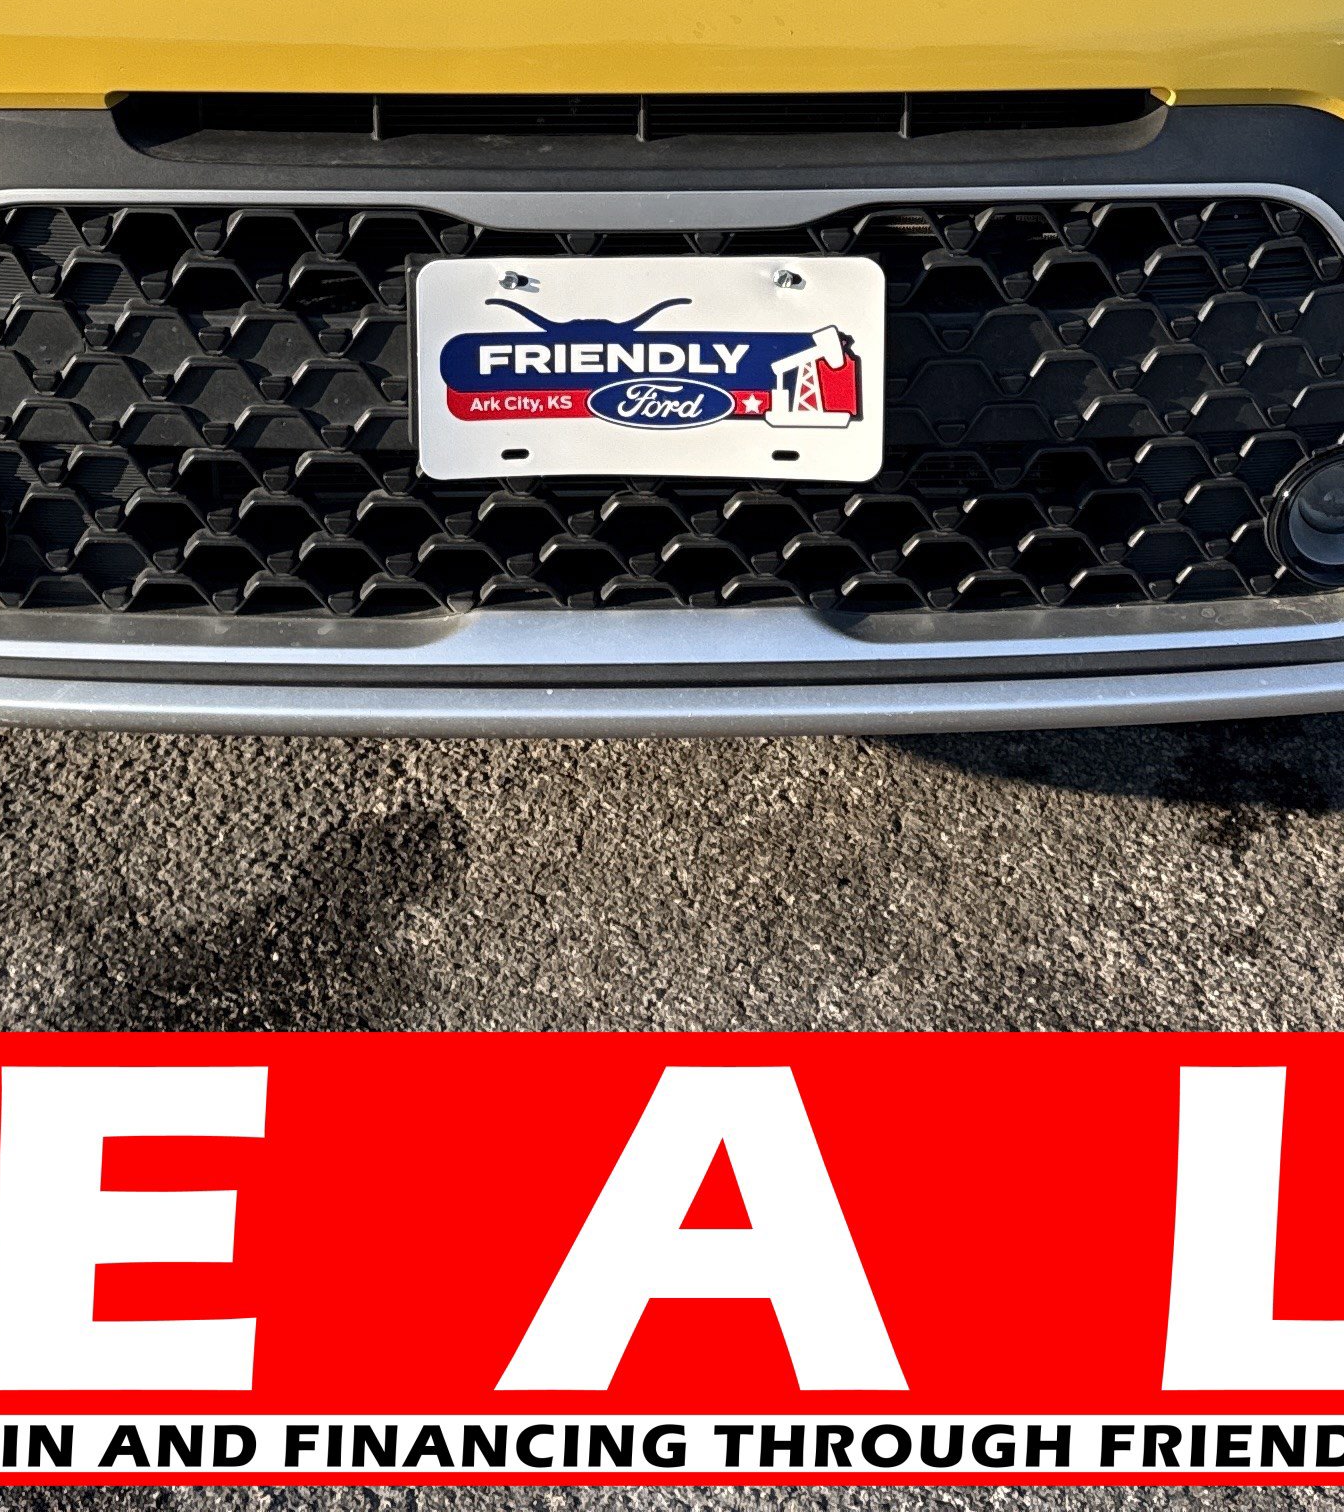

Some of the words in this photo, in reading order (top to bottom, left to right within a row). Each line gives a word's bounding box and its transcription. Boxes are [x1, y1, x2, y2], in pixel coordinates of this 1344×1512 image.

[478, 343, 750, 375] FRIENDLY
[469, 396, 501, 412] Ark
[504, 395, 544, 413] City,
[547, 395, 573, 410] KS
[617, 383, 705, 419] Ford
